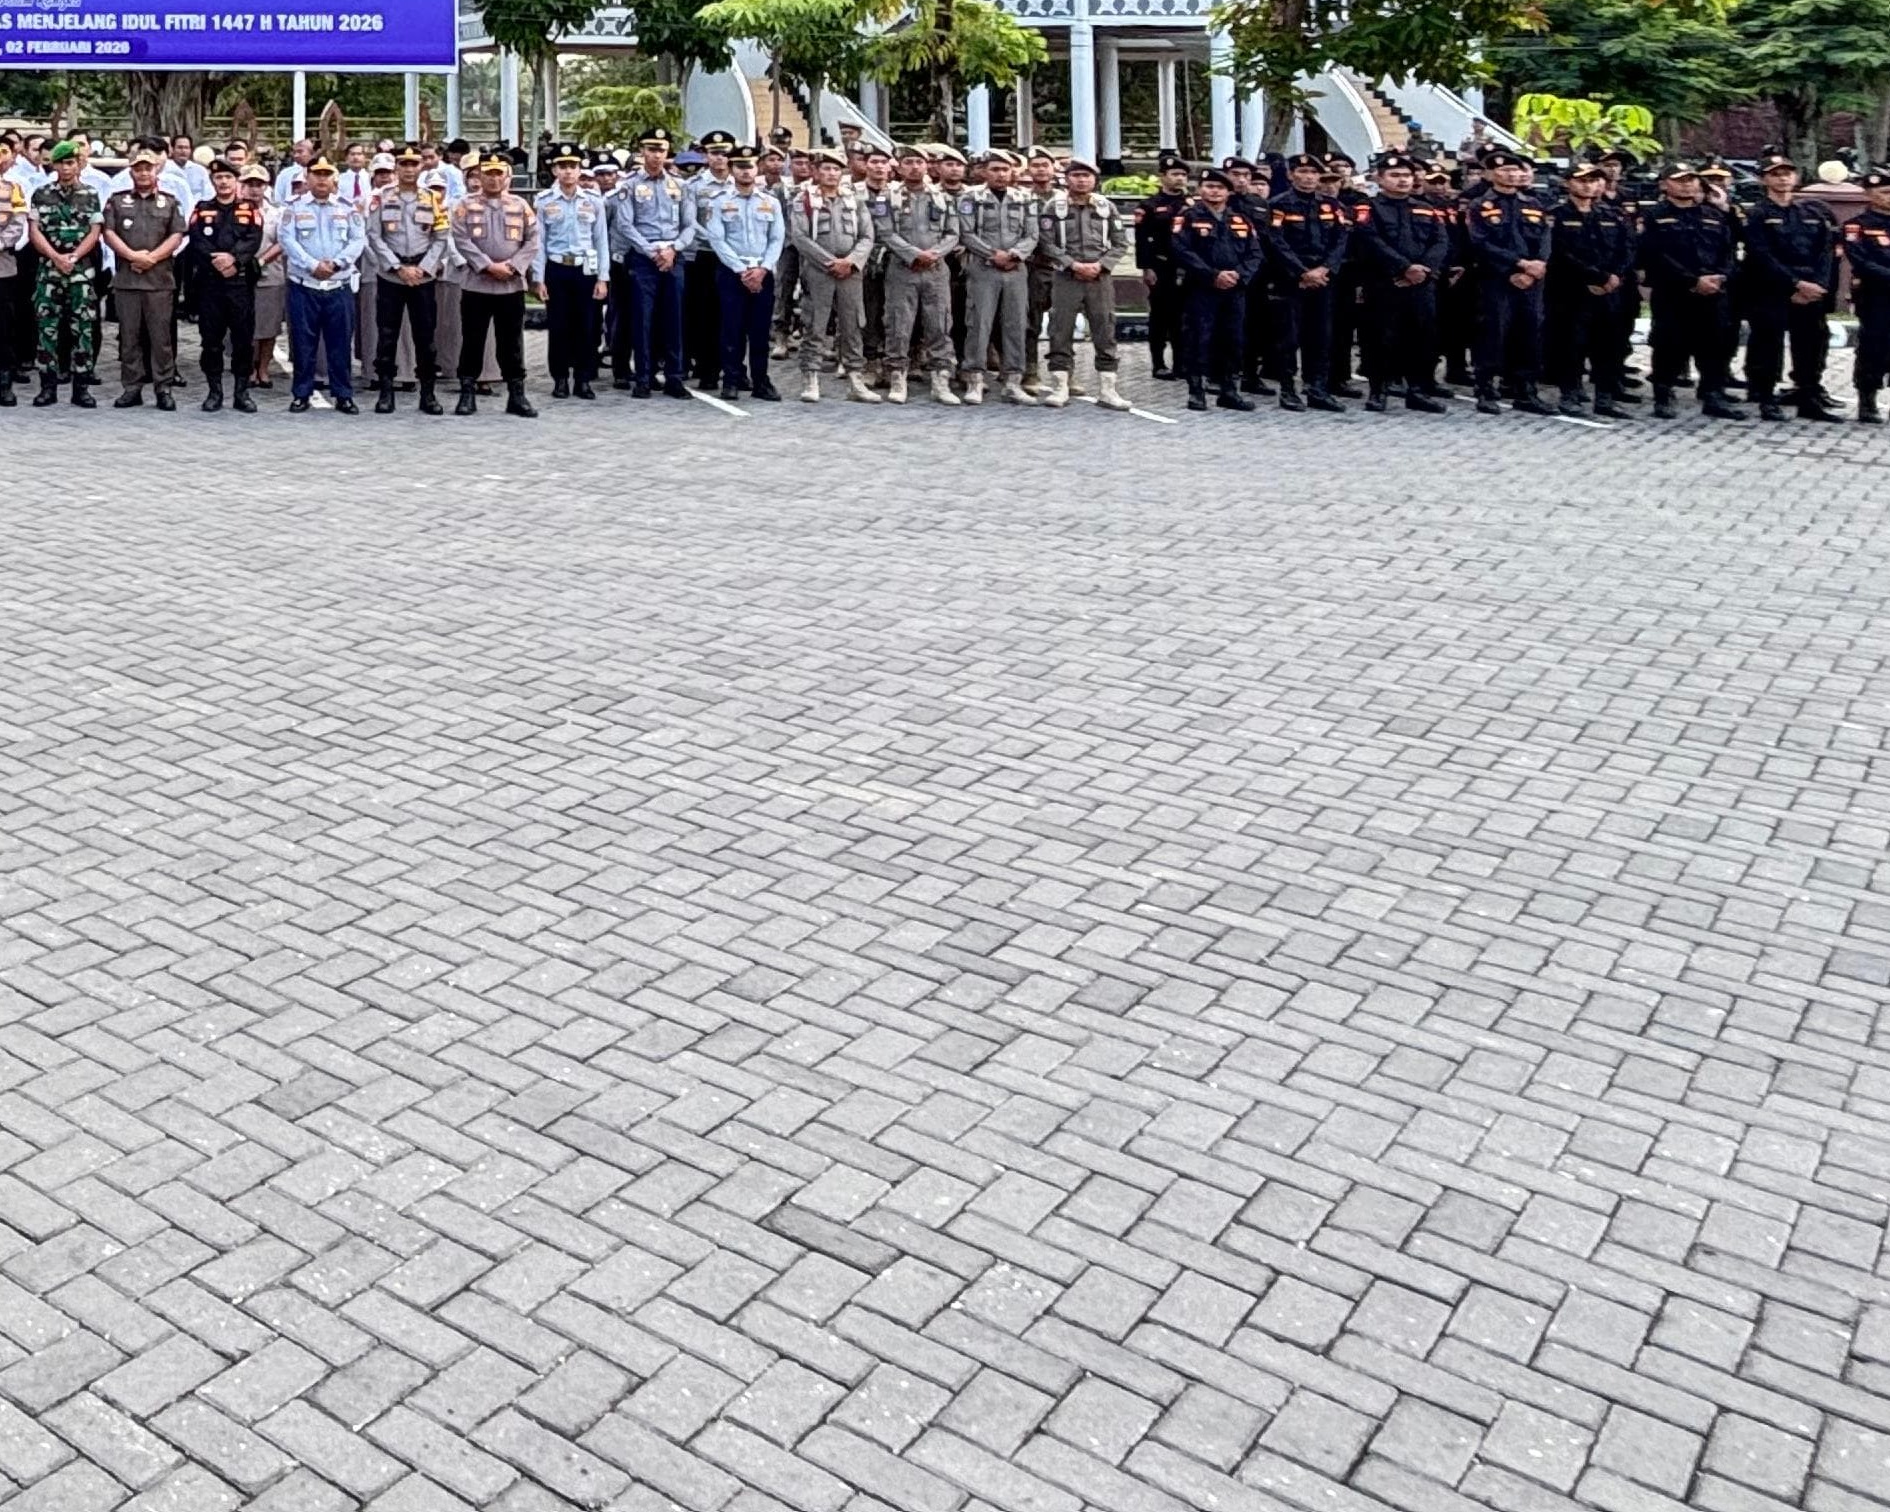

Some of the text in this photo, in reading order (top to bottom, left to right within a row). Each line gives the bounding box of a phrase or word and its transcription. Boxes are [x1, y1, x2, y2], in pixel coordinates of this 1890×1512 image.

[17, 13, 116, 30] MENJELANG
[122, 14, 160, 30] IDUL
[165, 14, 206, 31] FITRI
[211, 14, 255, 31] 1447
[260, 15, 272, 31] H
[277, 15, 334, 31] TAHUN
[339, 15, 384, 31] 2026
